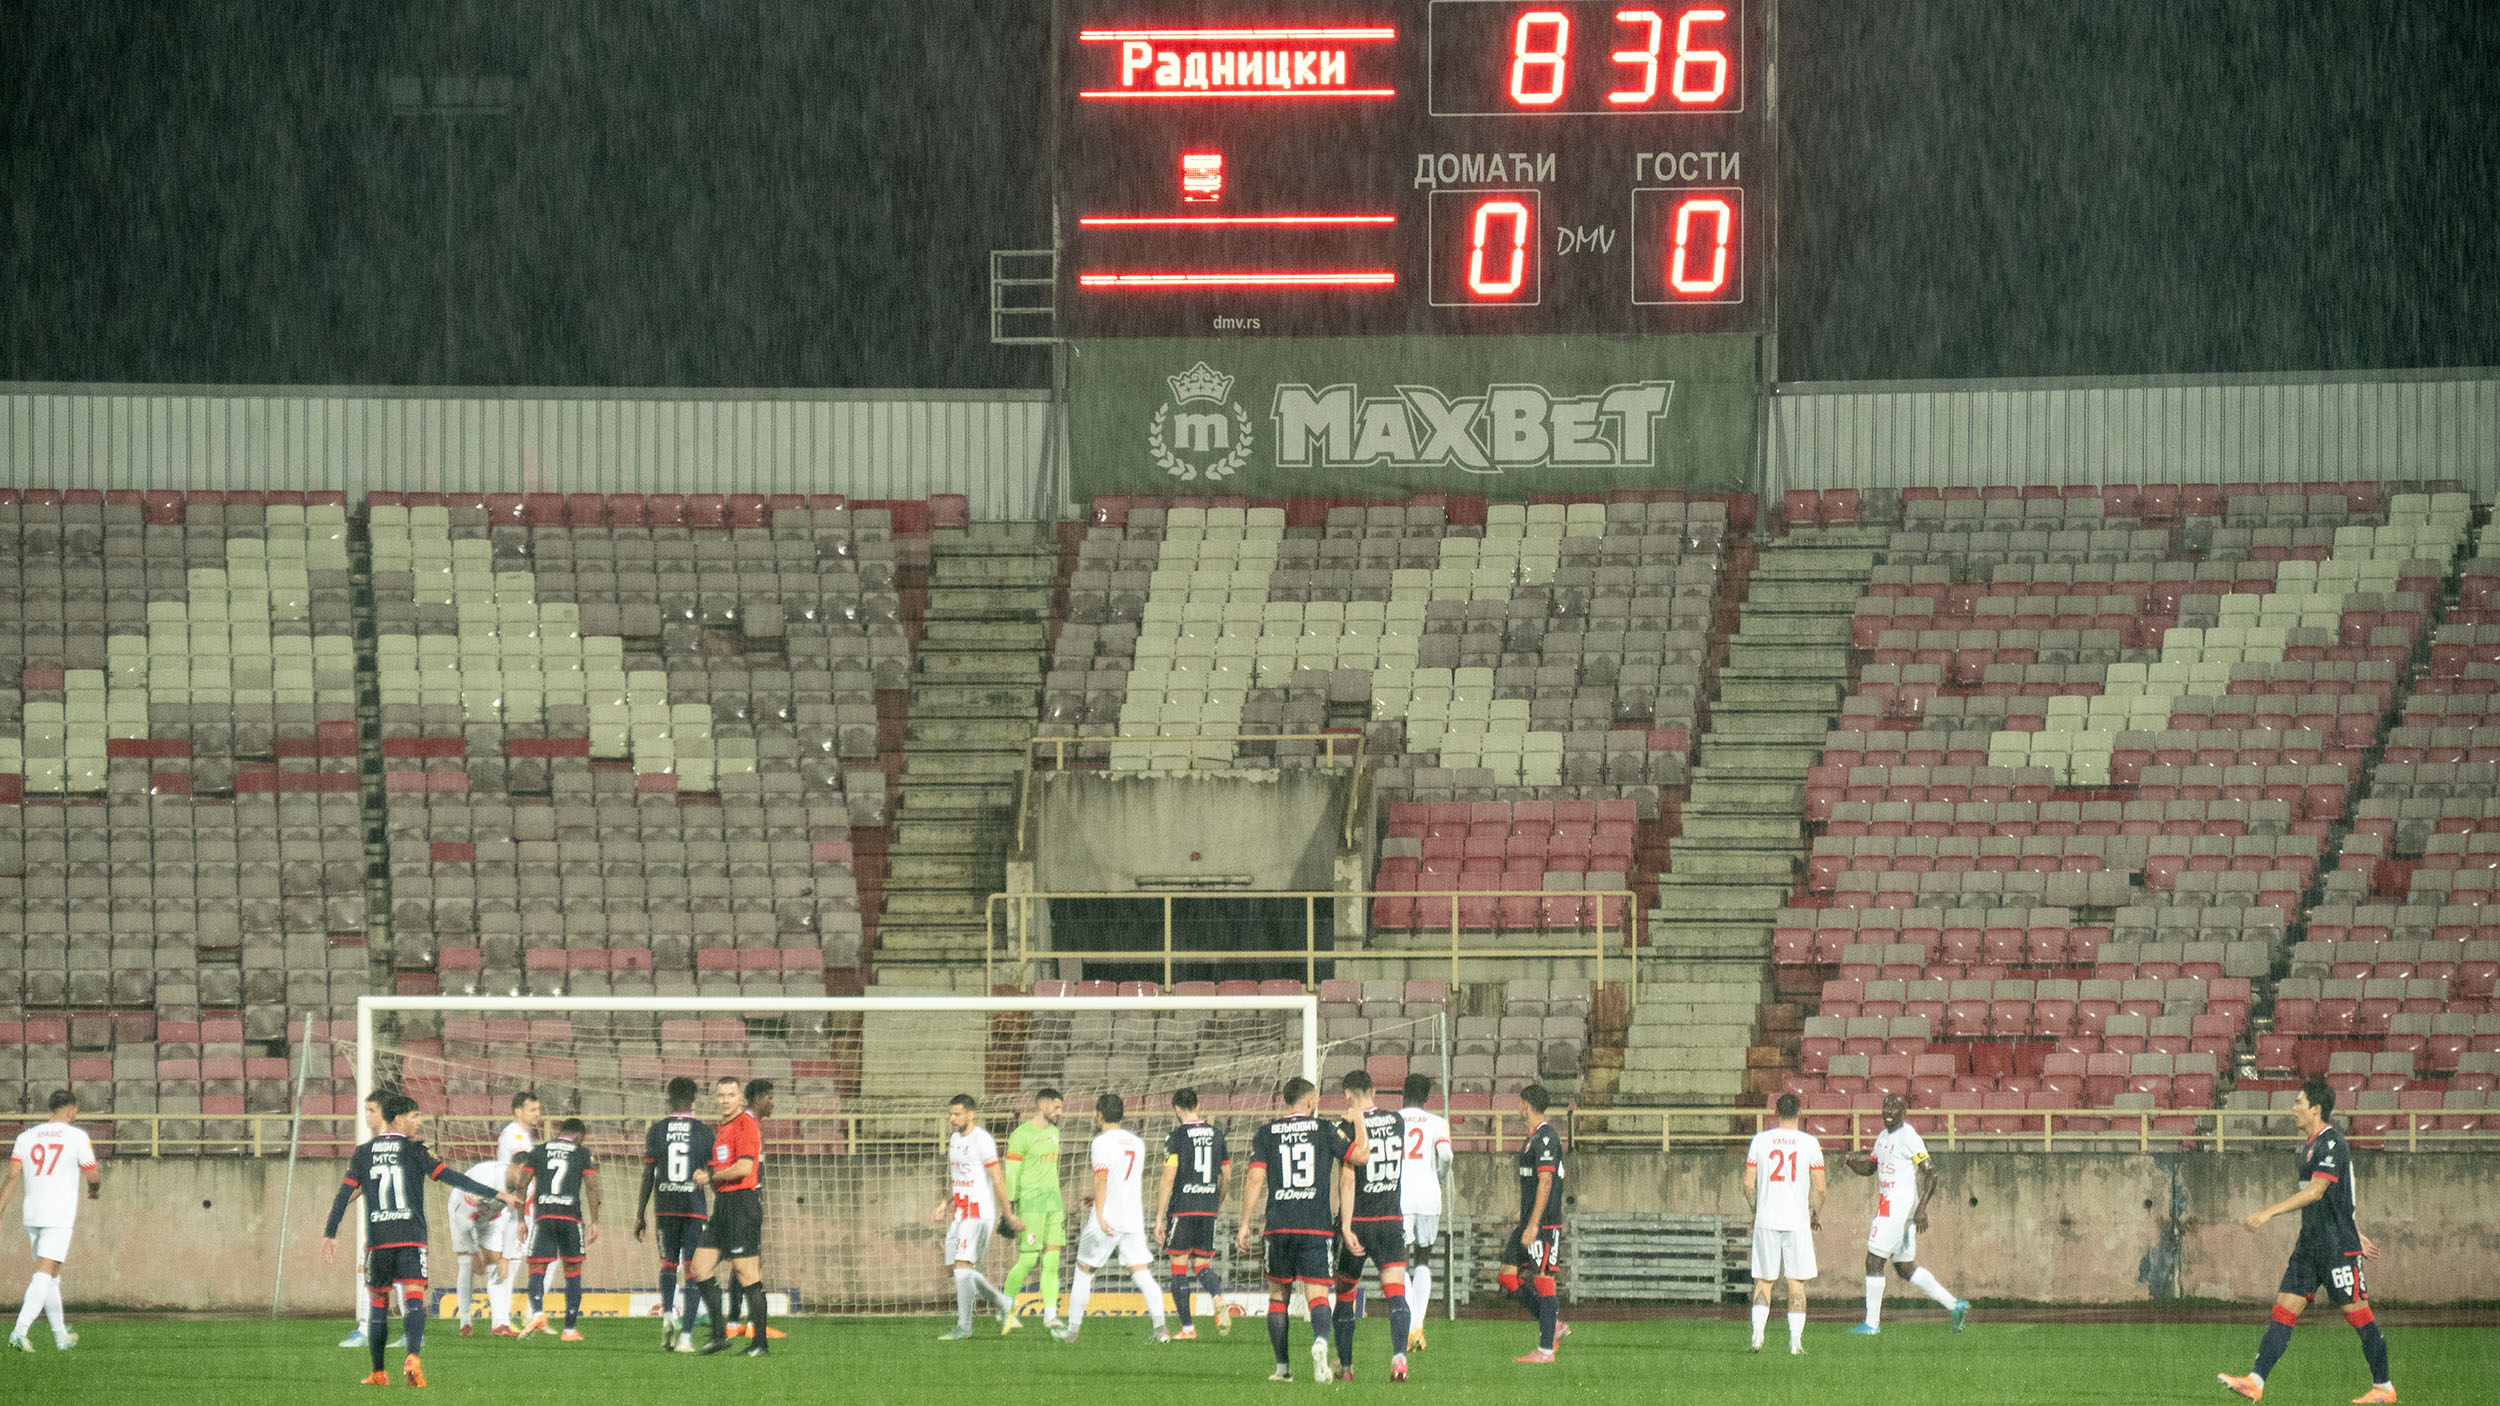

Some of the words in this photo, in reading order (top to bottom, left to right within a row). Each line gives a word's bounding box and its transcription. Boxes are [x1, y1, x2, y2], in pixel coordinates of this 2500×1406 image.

[1122, 41, 1346, 90] Радницки
[1511, 11, 1569, 104] 8
[1608, 10, 1727, 103] 36
[1414, 153, 1556, 189] ДОМАЋИ
[1636, 152, 1741, 182] ГОСТИ
[1470, 202, 1528, 294] 0
[1556, 225, 1616, 256] DMV
[1671, 200, 1730, 292] 0
[1213, 315, 1261, 329] dmv.rs
[1174, 413, 1229, 452] m
[666, 1133, 690, 1142] МТС
[1281, 1133, 1308, 1144] МТС
[1370, 1126, 1394, 1138] МТС
[30, 1143, 64, 1176] 97
[372, 1153, 399, 1165] МТС
[667, 1142, 689, 1182] 6
[1124, 1150, 1135, 1181] 7
[1194, 1146, 1212, 1184] 4
[1279, 1143, 1315, 1188] 13
[1768, 1149, 1798, 1183] 21
[369, 1165, 406, 1210] 71
[547, 1159, 568, 1195] 7
[2331, 1265, 2354, 1289] 66
